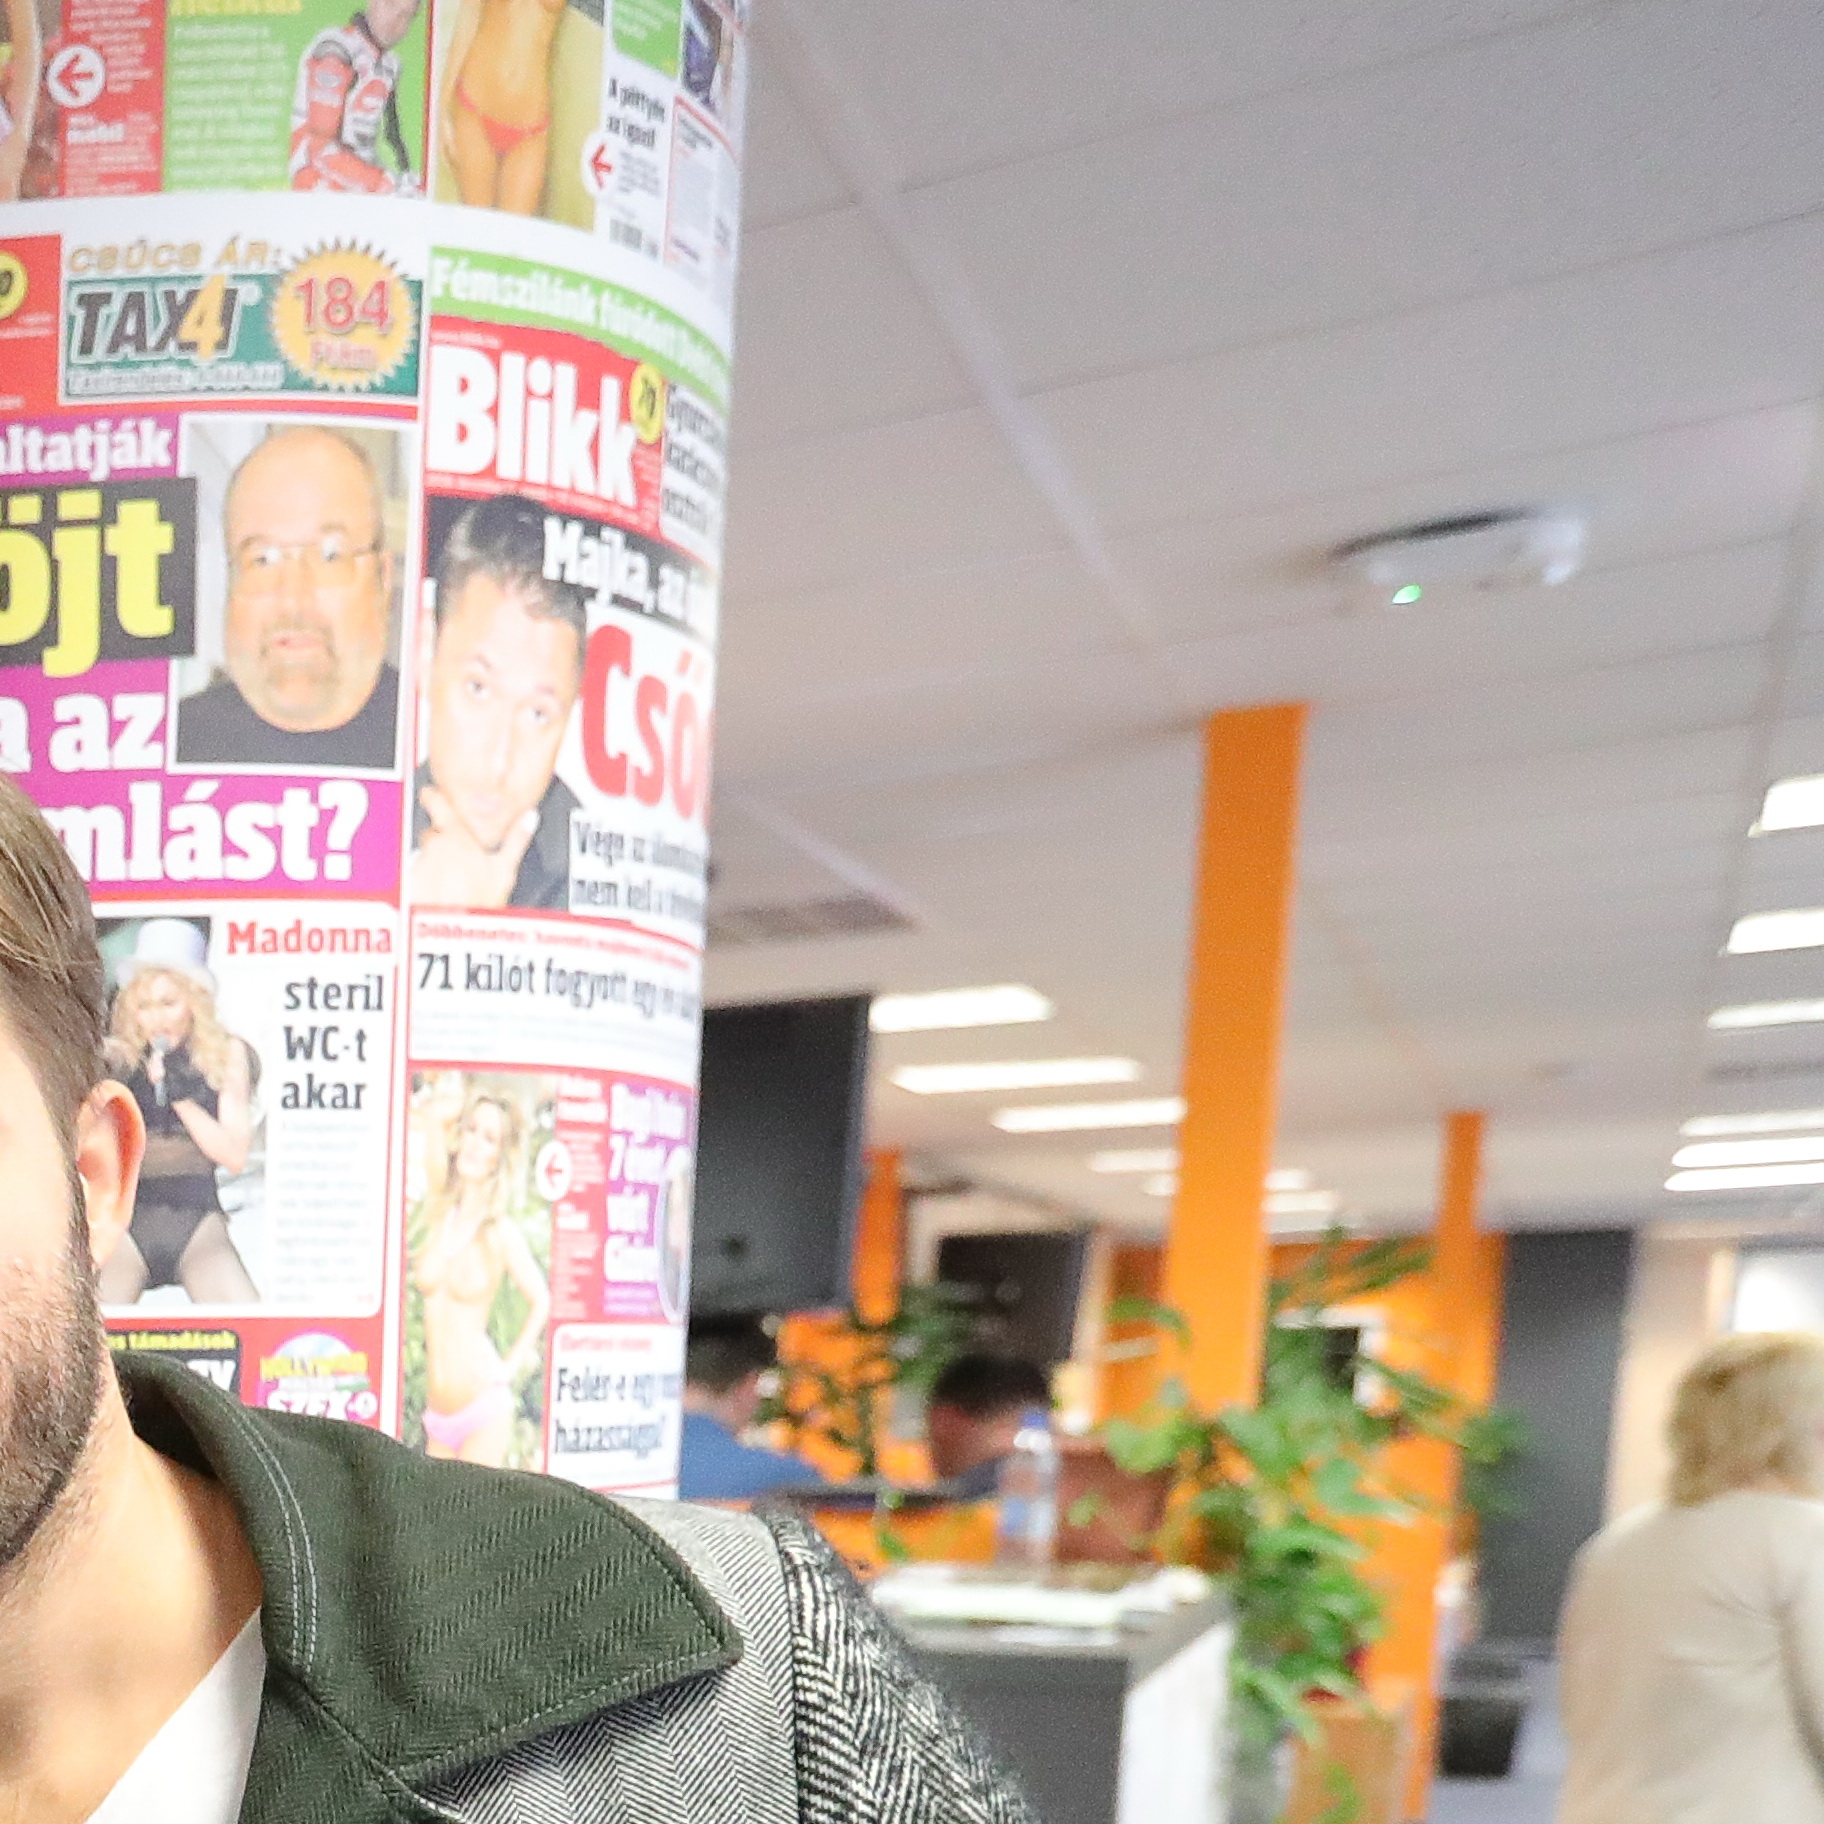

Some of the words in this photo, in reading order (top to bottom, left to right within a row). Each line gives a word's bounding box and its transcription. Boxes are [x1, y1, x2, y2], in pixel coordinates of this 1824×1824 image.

[294, 276, 395, 336] 184
[427, 345, 636, 507] Blikk
[48, 692, 166, 773] az
[227, 918, 391, 955] Madonna
[284, 973, 384, 1012] steril
[417, 952, 453, 991] 71
[464, 952, 534, 995] kilót
[283, 1025, 367, 1062] WC-t
[281, 1073, 367, 1111] akar
